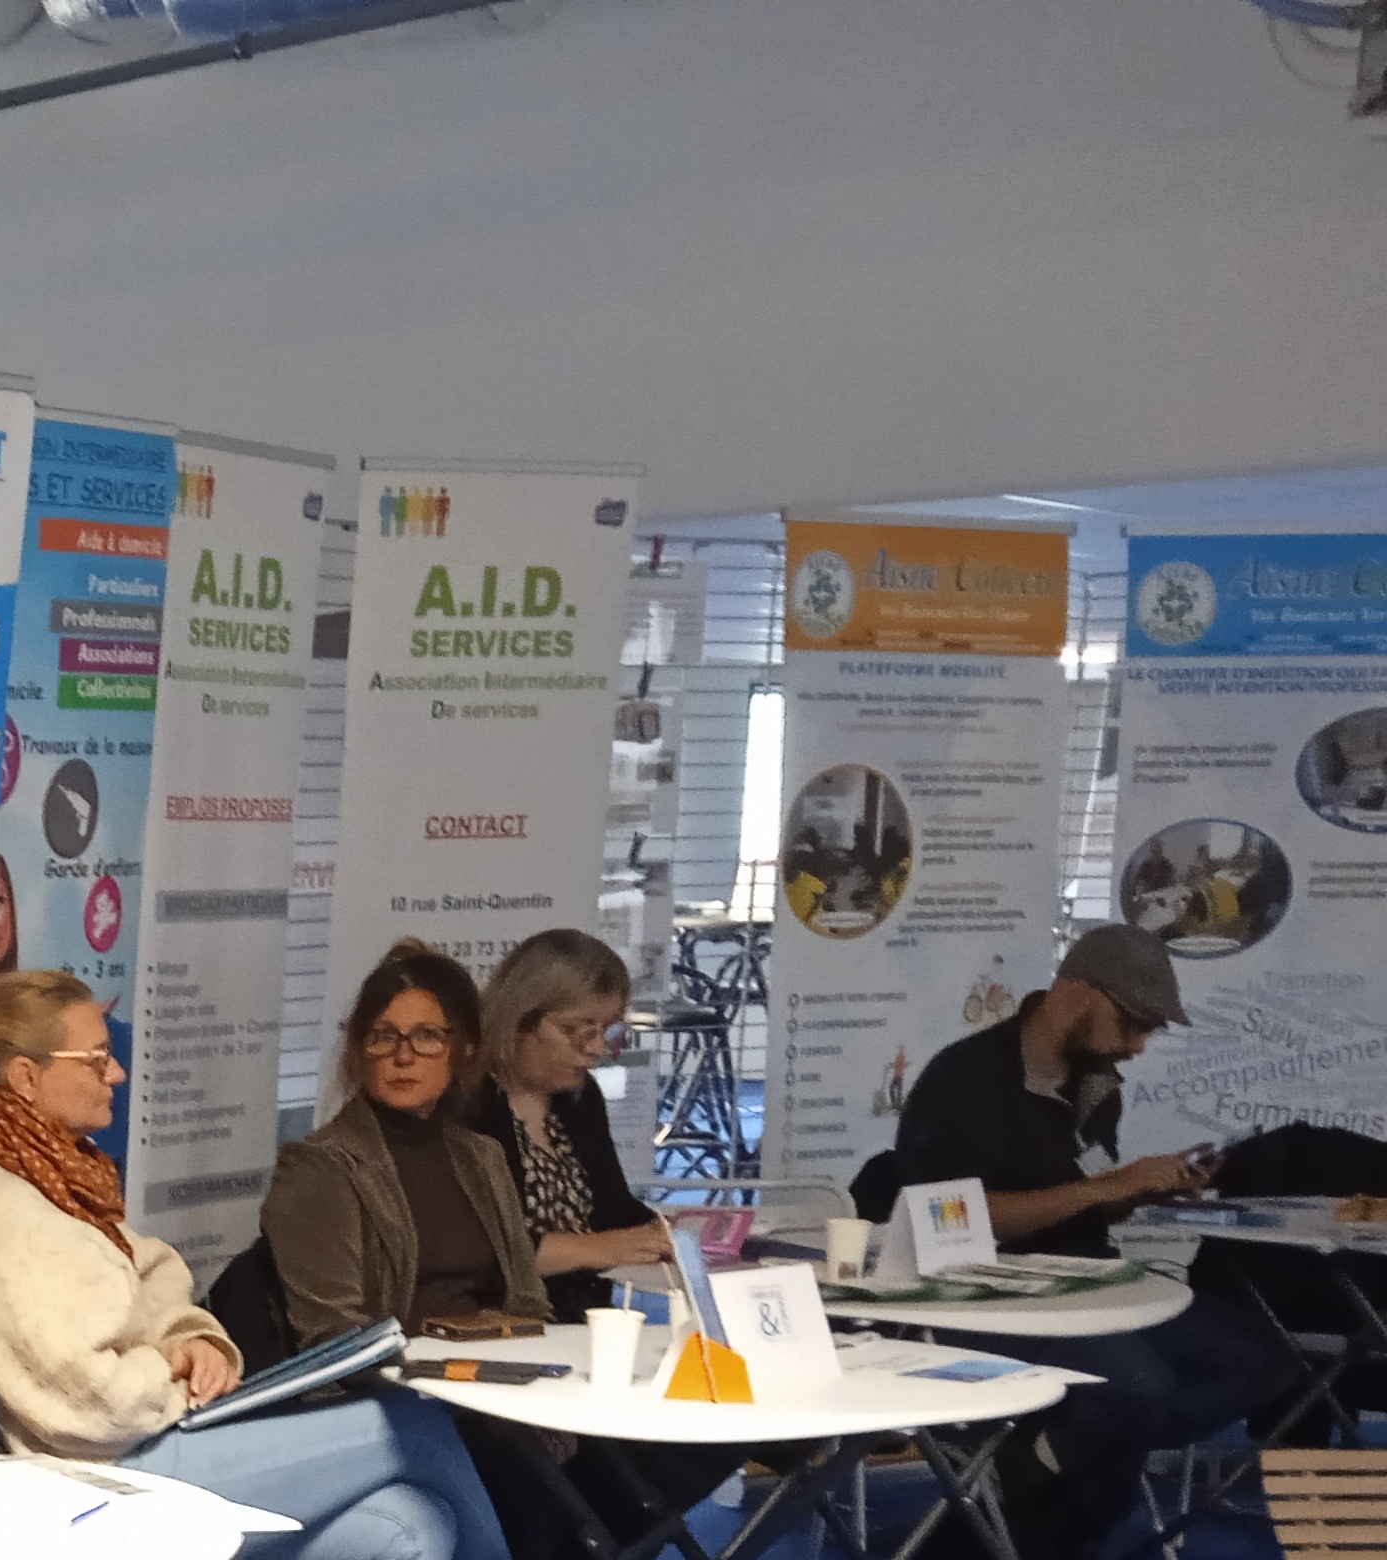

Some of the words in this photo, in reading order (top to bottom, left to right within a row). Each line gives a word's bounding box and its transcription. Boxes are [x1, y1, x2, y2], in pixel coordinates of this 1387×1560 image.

[46, 472, 74, 500] ET
[80, 476, 167, 511] SERVICES
[191, 548, 293, 614] A.I.D.
[413, 563, 577, 618] A.I.D.
[77, 642, 155, 666] Associations
[188, 615, 291, 655] SERVICES
[410, 628, 575, 658] SERVICES
[425, 814, 528, 839] CONTACT
[1132, 1036, 1387, 1111] Accompagneme
